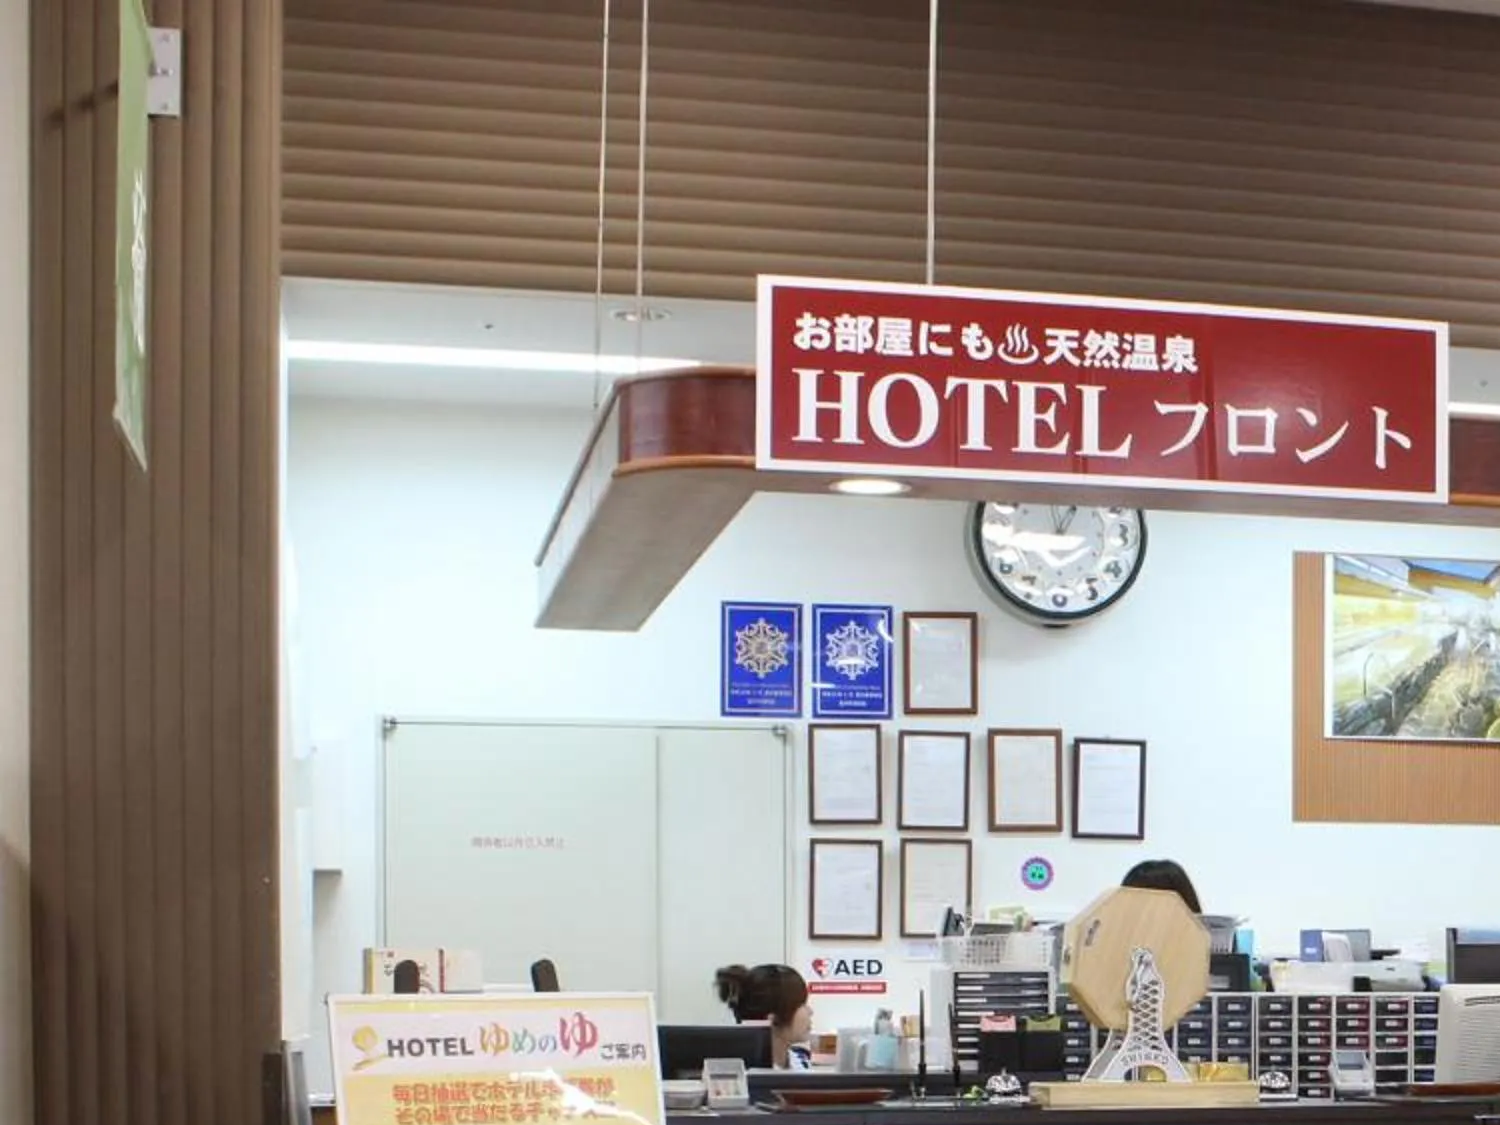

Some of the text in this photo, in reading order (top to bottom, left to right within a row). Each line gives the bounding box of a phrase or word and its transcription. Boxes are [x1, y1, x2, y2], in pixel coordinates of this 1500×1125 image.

[793, 312, 1198, 374] お部屋にも 天然温泉
[792, 367, 1412, 470] HOTEL フロント
[834, 959, 883, 975] AED
[387, 1037, 474, 1058] HOTEL
[479, 1011, 598, 1058] ゆめのゆ
